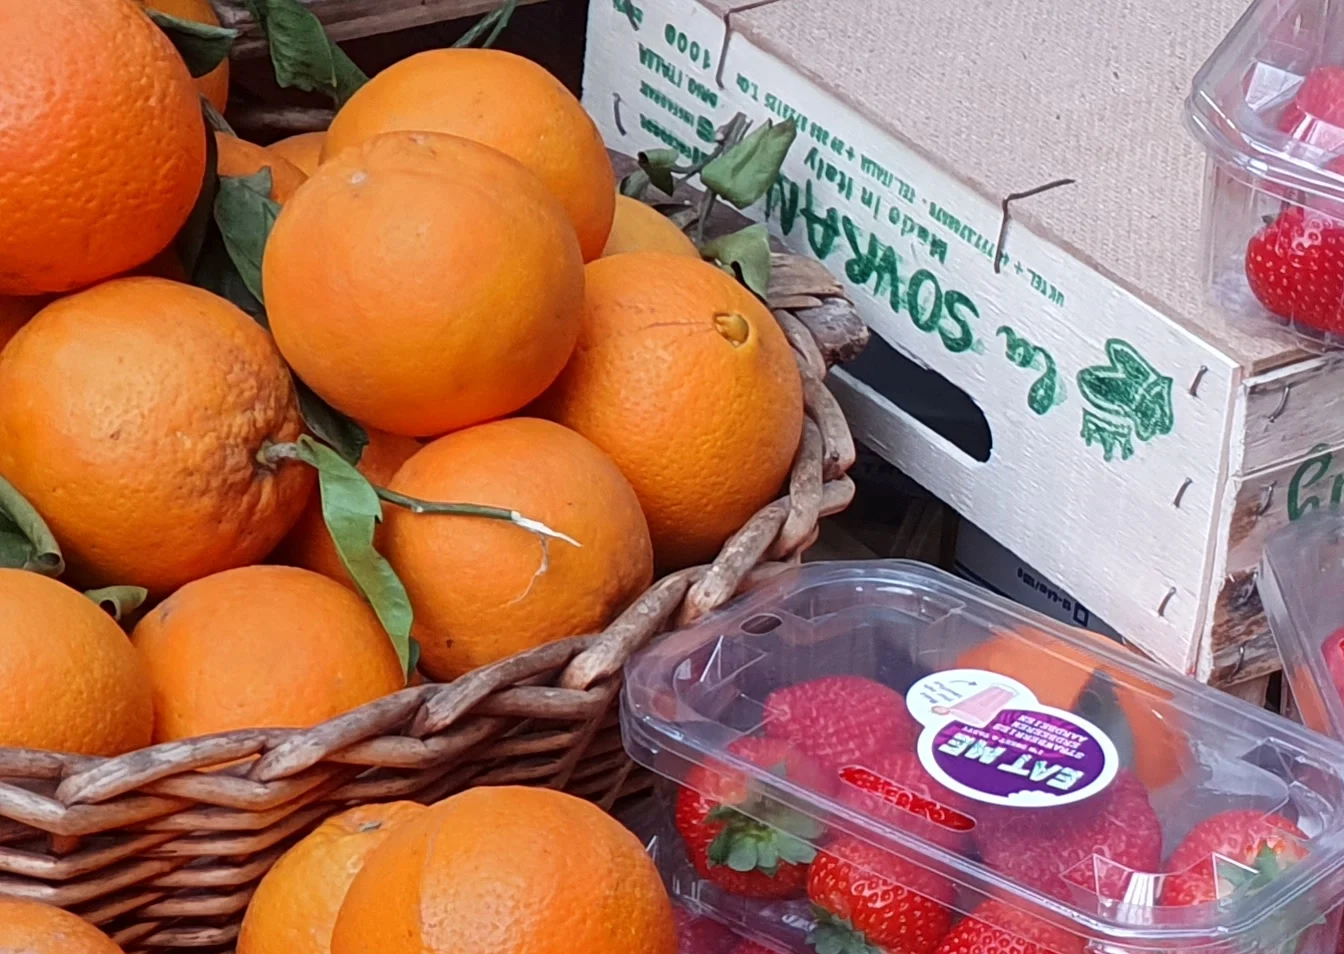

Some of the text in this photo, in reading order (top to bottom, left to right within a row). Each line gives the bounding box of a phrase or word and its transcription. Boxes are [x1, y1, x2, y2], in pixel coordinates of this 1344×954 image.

[665, 24, 712, 71] 1000
[804, 146, 857, 200] Italy
[851, 187, 883, 222] in
[764, 170, 981, 354] SOVRAN
[880, 207, 947, 264] Made
[938, 732, 1085, 791] EAT ME
[991, 722, 1086, 760] STRAWBERRIES
